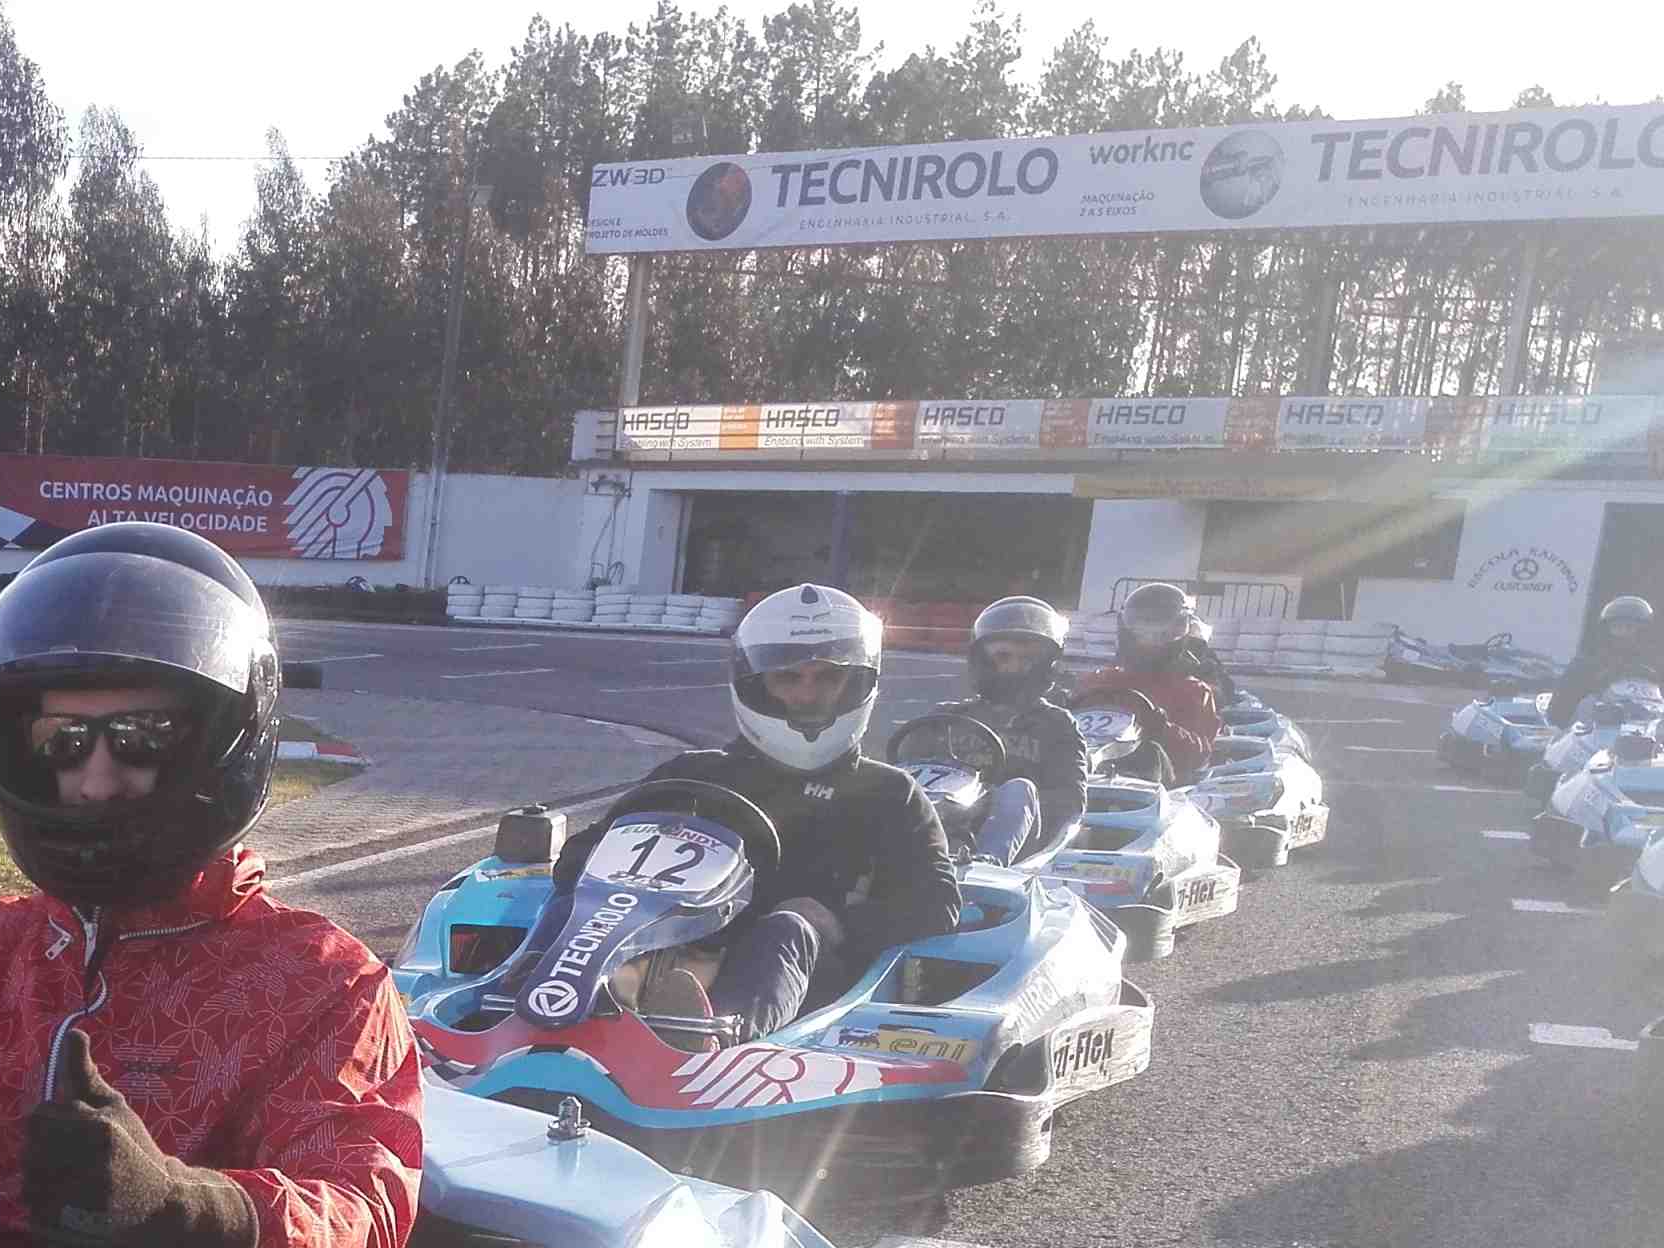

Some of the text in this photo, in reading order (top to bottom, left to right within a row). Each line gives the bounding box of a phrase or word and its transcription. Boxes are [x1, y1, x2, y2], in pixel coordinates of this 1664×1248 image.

[1089, 136, 1195, 164] worknc
[771, 147, 1059, 208] TECNIROLO
[622, 411, 690, 431] HASCO
[766, 409, 840, 429] HASCO
[923, 406, 1006, 427] HASCO
[1096, 404, 1186, 426] HASCO
[1284, 403, 1385, 425] HASCO
[39, 480, 273, 510] CENTROS MAQUINAÇÃO
[632, 834, 706, 886] 12
[889, 1038, 968, 1060] eni
